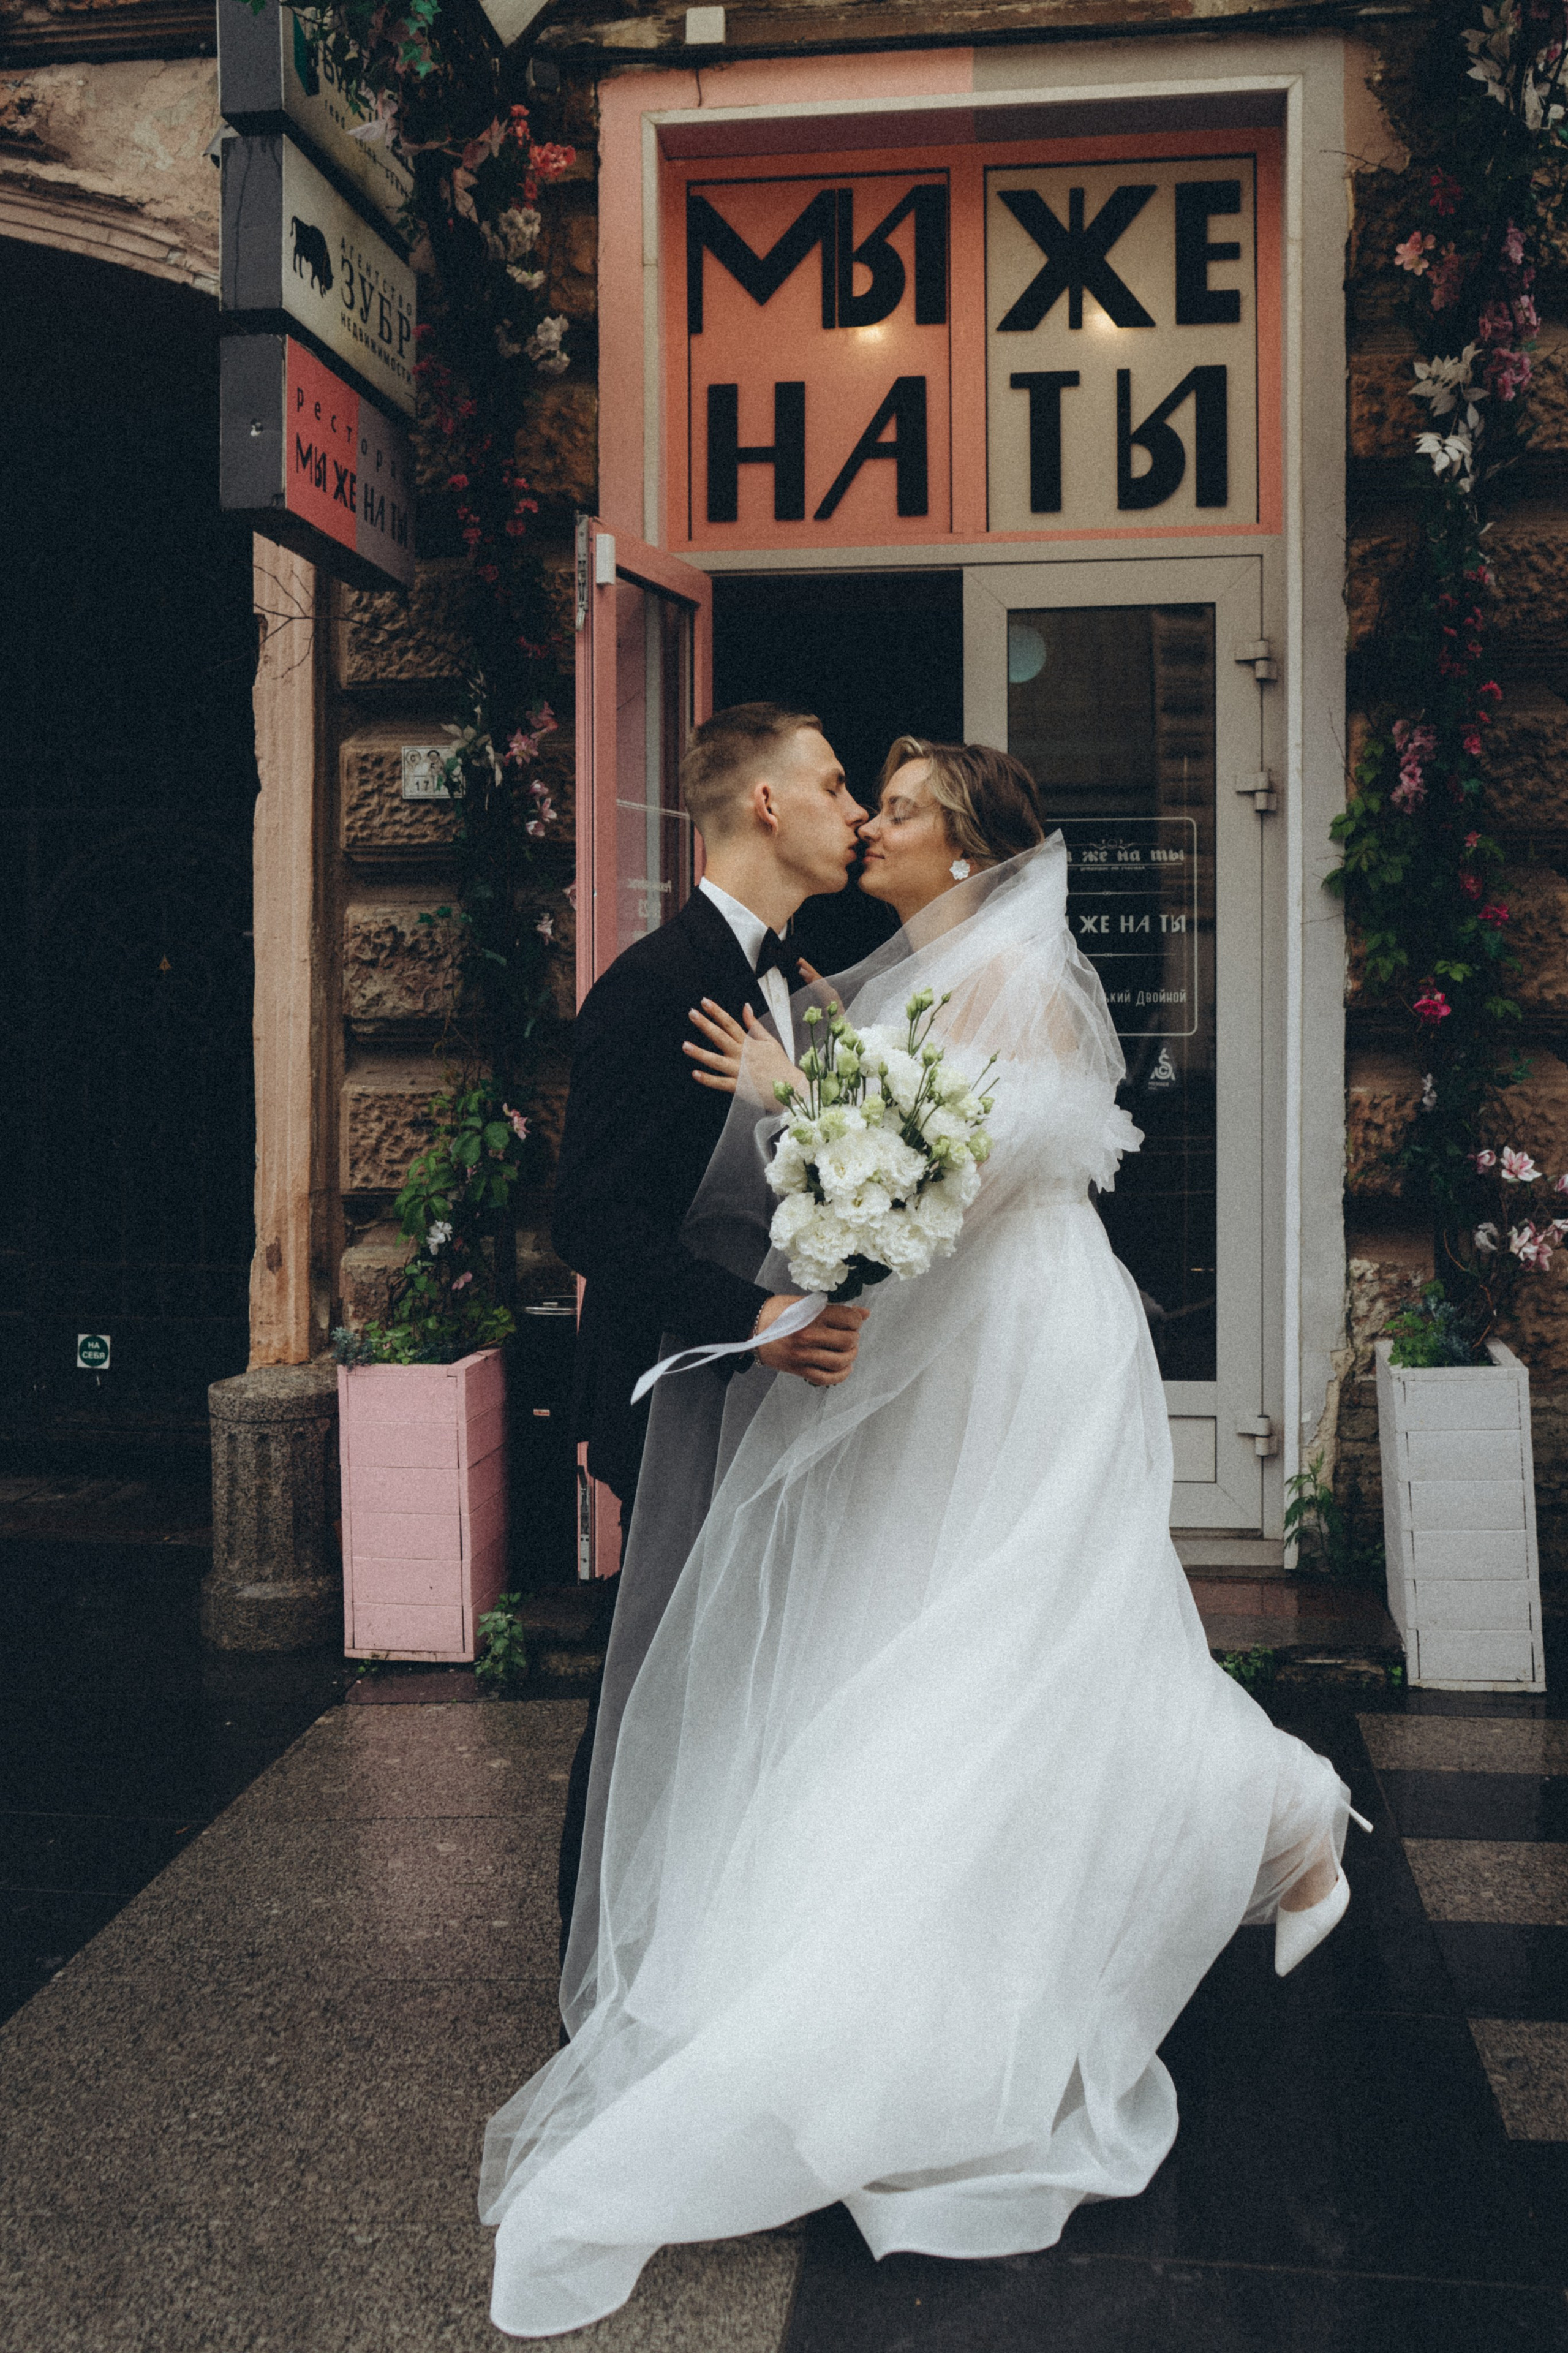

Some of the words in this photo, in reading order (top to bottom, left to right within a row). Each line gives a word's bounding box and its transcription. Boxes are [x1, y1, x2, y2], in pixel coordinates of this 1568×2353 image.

[341, 237, 412, 317] АГЕНТСТВО
[688, 184, 947, 335] МЫ
[996, 179, 1241, 331] ЖЕ
[341, 254, 412, 360] ЗУБР
[341, 312, 412, 385] НЕДВИЖИМОСТИ
[296, 387, 402, 483] рестора
[707, 374, 929, 522] НА
[1009, 364, 1227, 513] ТЫ
[296, 432, 327, 492] МЫ
[333, 459, 357, 513] ЖЕ
[364, 483, 385, 533] НА
[1082, 850, 1108, 862] же
[1117, 850, 1140, 862] на
[1150, 849, 1185, 861] ты
[1079, 915, 1110, 934] ЖЕ
[1120, 915, 1150, 933] НА
[1159, 915, 1186, 933] ТЫ
[1136, 989, 1187, 1007] Двойной
[82, 1351, 106, 1359] СЕБЯ
